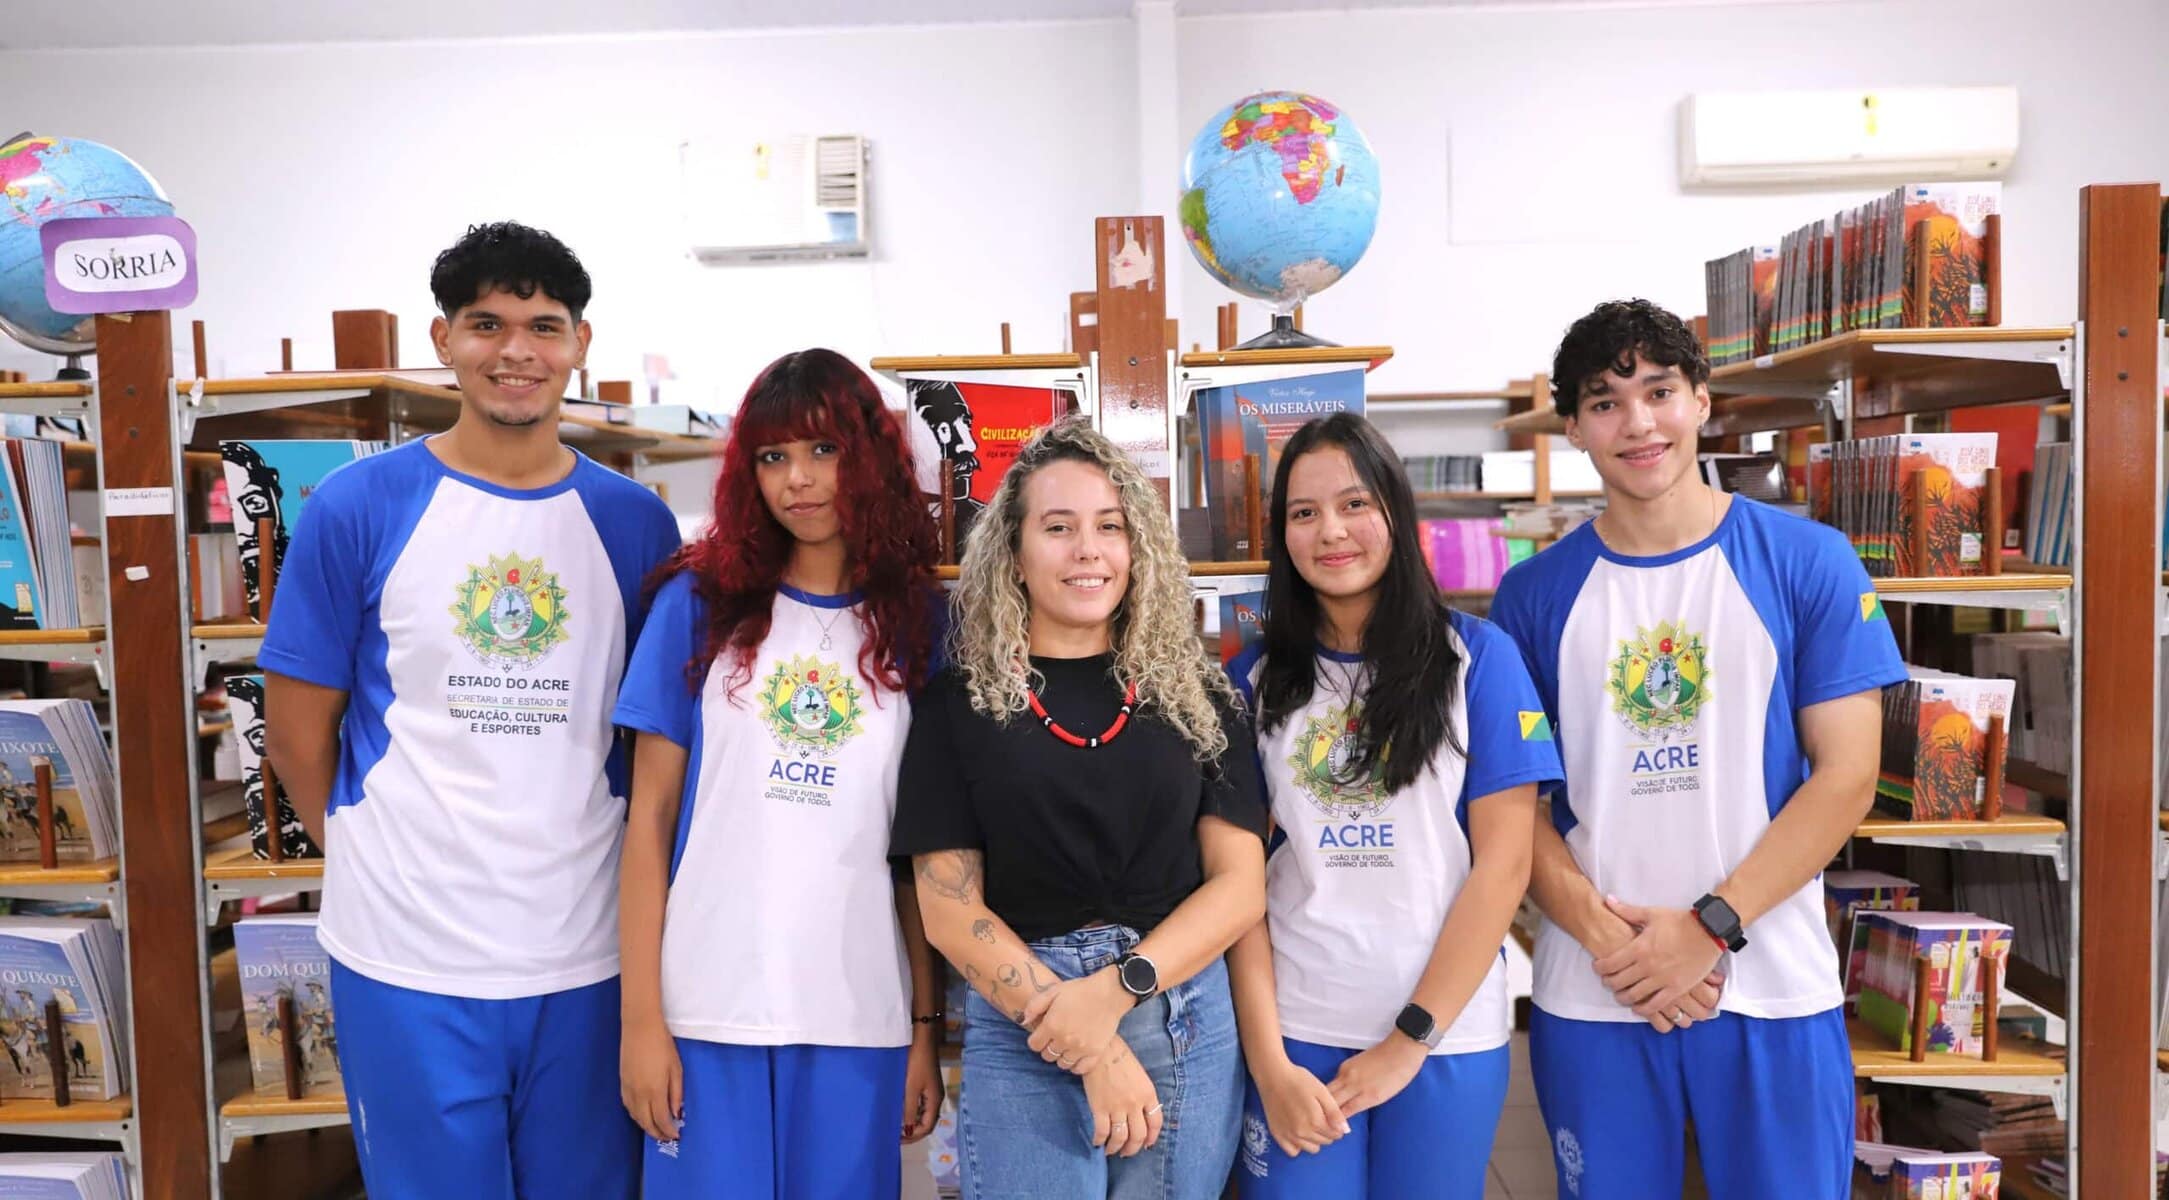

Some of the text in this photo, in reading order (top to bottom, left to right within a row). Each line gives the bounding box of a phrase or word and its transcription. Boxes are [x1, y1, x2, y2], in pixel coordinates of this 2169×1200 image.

[74, 248, 177, 281] SORRIA
[1240, 400, 1345, 415] OS MISERÁVEIS
[1237, 610, 1257, 623] OS
[448, 675, 570, 691] ESTADO DO ACRE
[447, 694, 568, 707] SECRETARIA DE ESTADO DE
[515, 712, 568, 723] CULTURA
[471, 723, 541, 735] E ESPORTES
[1631, 744, 1699, 773] ACRE
[769, 759, 836, 786] ACRE
[1319, 824, 1394, 848] ACRE
[3, 968, 80, 987] QUIXOTE
[244, 963, 289, 978] DOM
